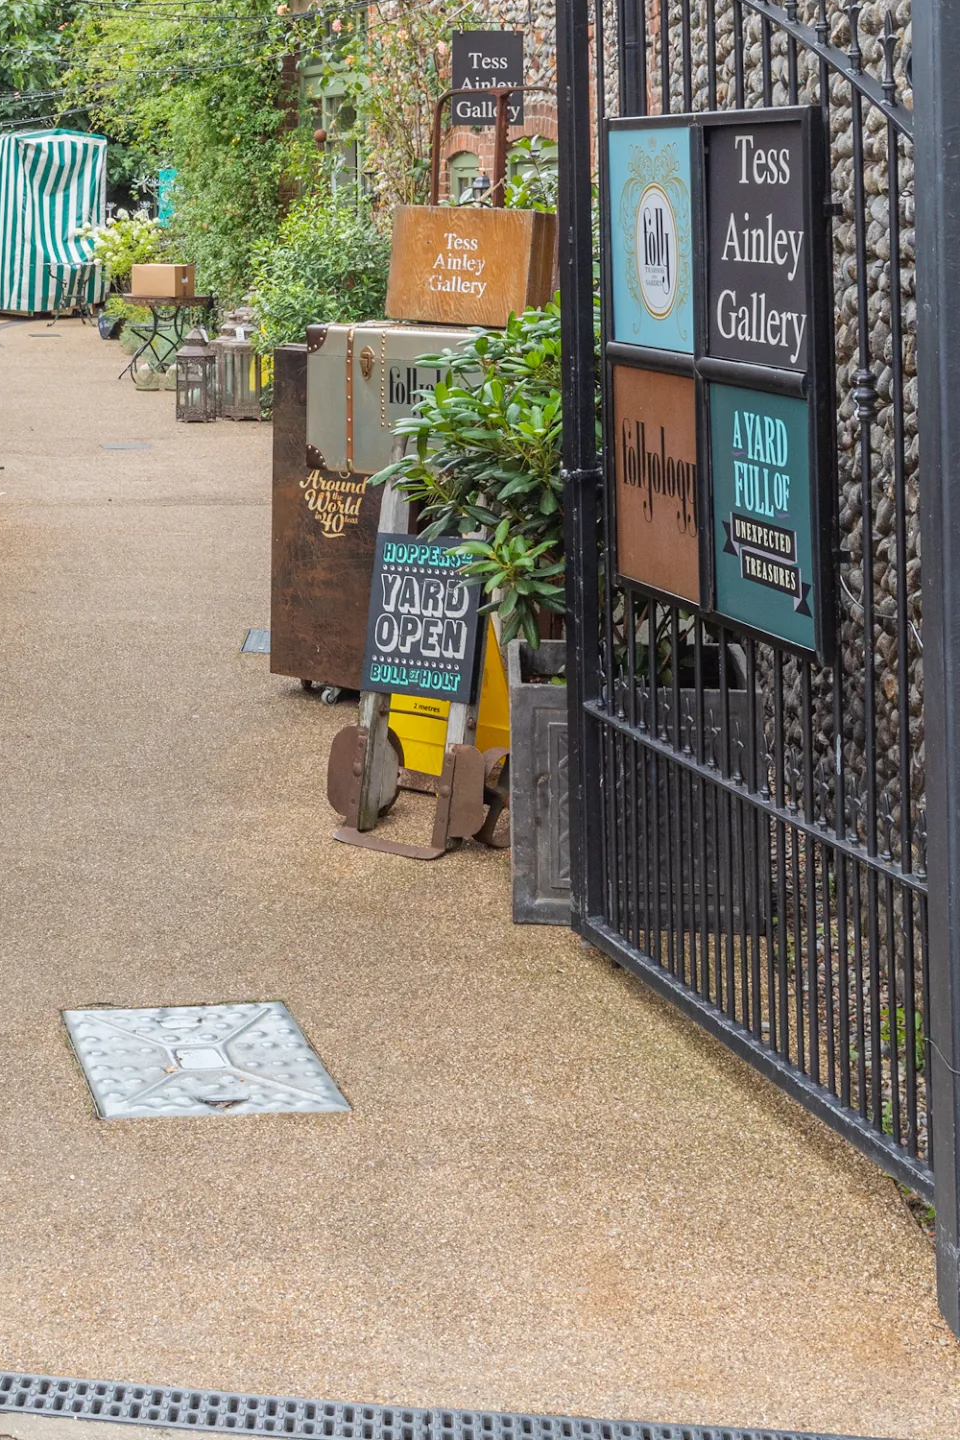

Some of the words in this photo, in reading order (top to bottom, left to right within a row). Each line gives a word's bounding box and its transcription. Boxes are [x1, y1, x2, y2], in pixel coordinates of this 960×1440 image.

[468, 53, 508, 69] Tess
[456, 101, 520, 122] Gally
[735, 135, 790, 184] Tess
[444, 233, 478, 250] Tess
[643, 207, 670, 295] folly
[721, 212, 804, 281] Ainley
[432, 253, 485, 276] Ainley
[429, 274, 487, 298] Gallery
[717, 289, 807, 363] Gallery
[733, 410, 743, 449] A
[743, 411, 788, 467] YARD
[299, 469, 369, 495] Around
[622, 418, 697, 538] follyology
[733, 460, 774, 517] FULL
[774, 472, 790, 512] OF
[304, 489, 362, 516] World
[320, 512, 344, 532] 40
[735, 519, 791, 554] UNEXPECTED
[745, 556, 796, 591] TREASURES
[381, 573, 469, 618] YARD
[374, 612, 468, 660] OPEN
[370, 663, 408, 686] BULL
[419, 669, 461, 692] HOLT
[419, 704, 440, 713] metres
